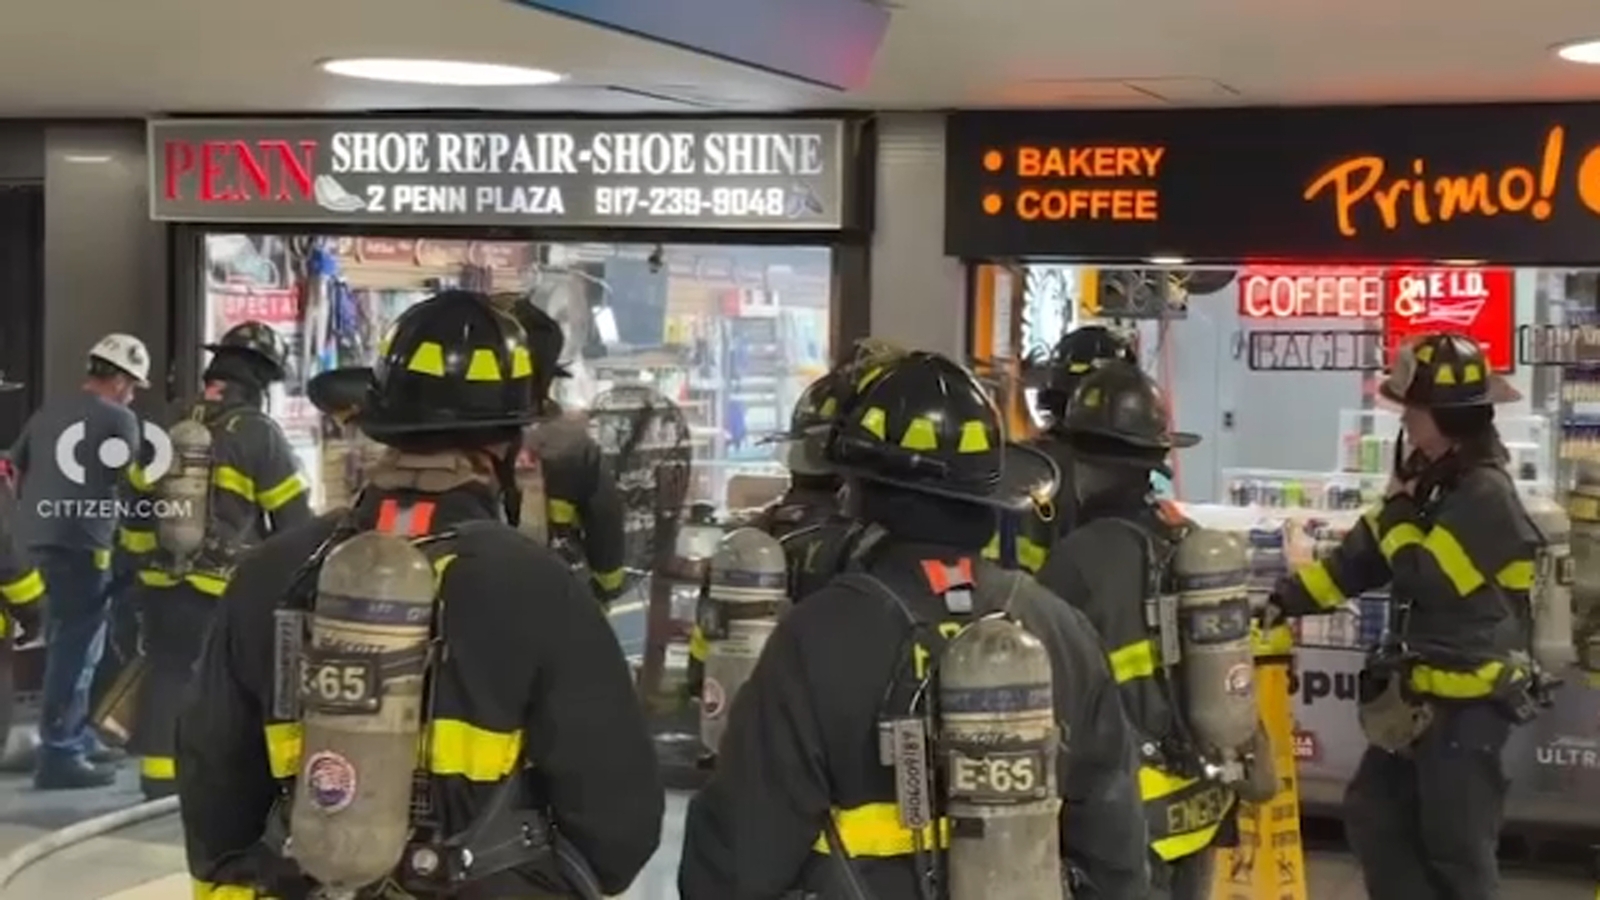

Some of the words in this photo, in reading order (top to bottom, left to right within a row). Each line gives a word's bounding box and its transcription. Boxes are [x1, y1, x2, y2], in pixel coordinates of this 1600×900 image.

[163, 139, 318, 202] PENN
[331, 132, 430, 174] SHOE
[704, 132, 825, 175] SHINE
[1017, 147, 1165, 177] BAKERY
[1303, 125, 1564, 236] Primo!
[366, 185, 386, 213] 2
[393, 185, 467, 213] PENN
[476, 186, 565, 214] PLAZA
[595, 186, 784, 216] 917-239-9048
[1016, 189, 1158, 220] COFFEE
[1244, 275, 1381, 317] COFFEE
[955, 756, 1034, 792] E-65
